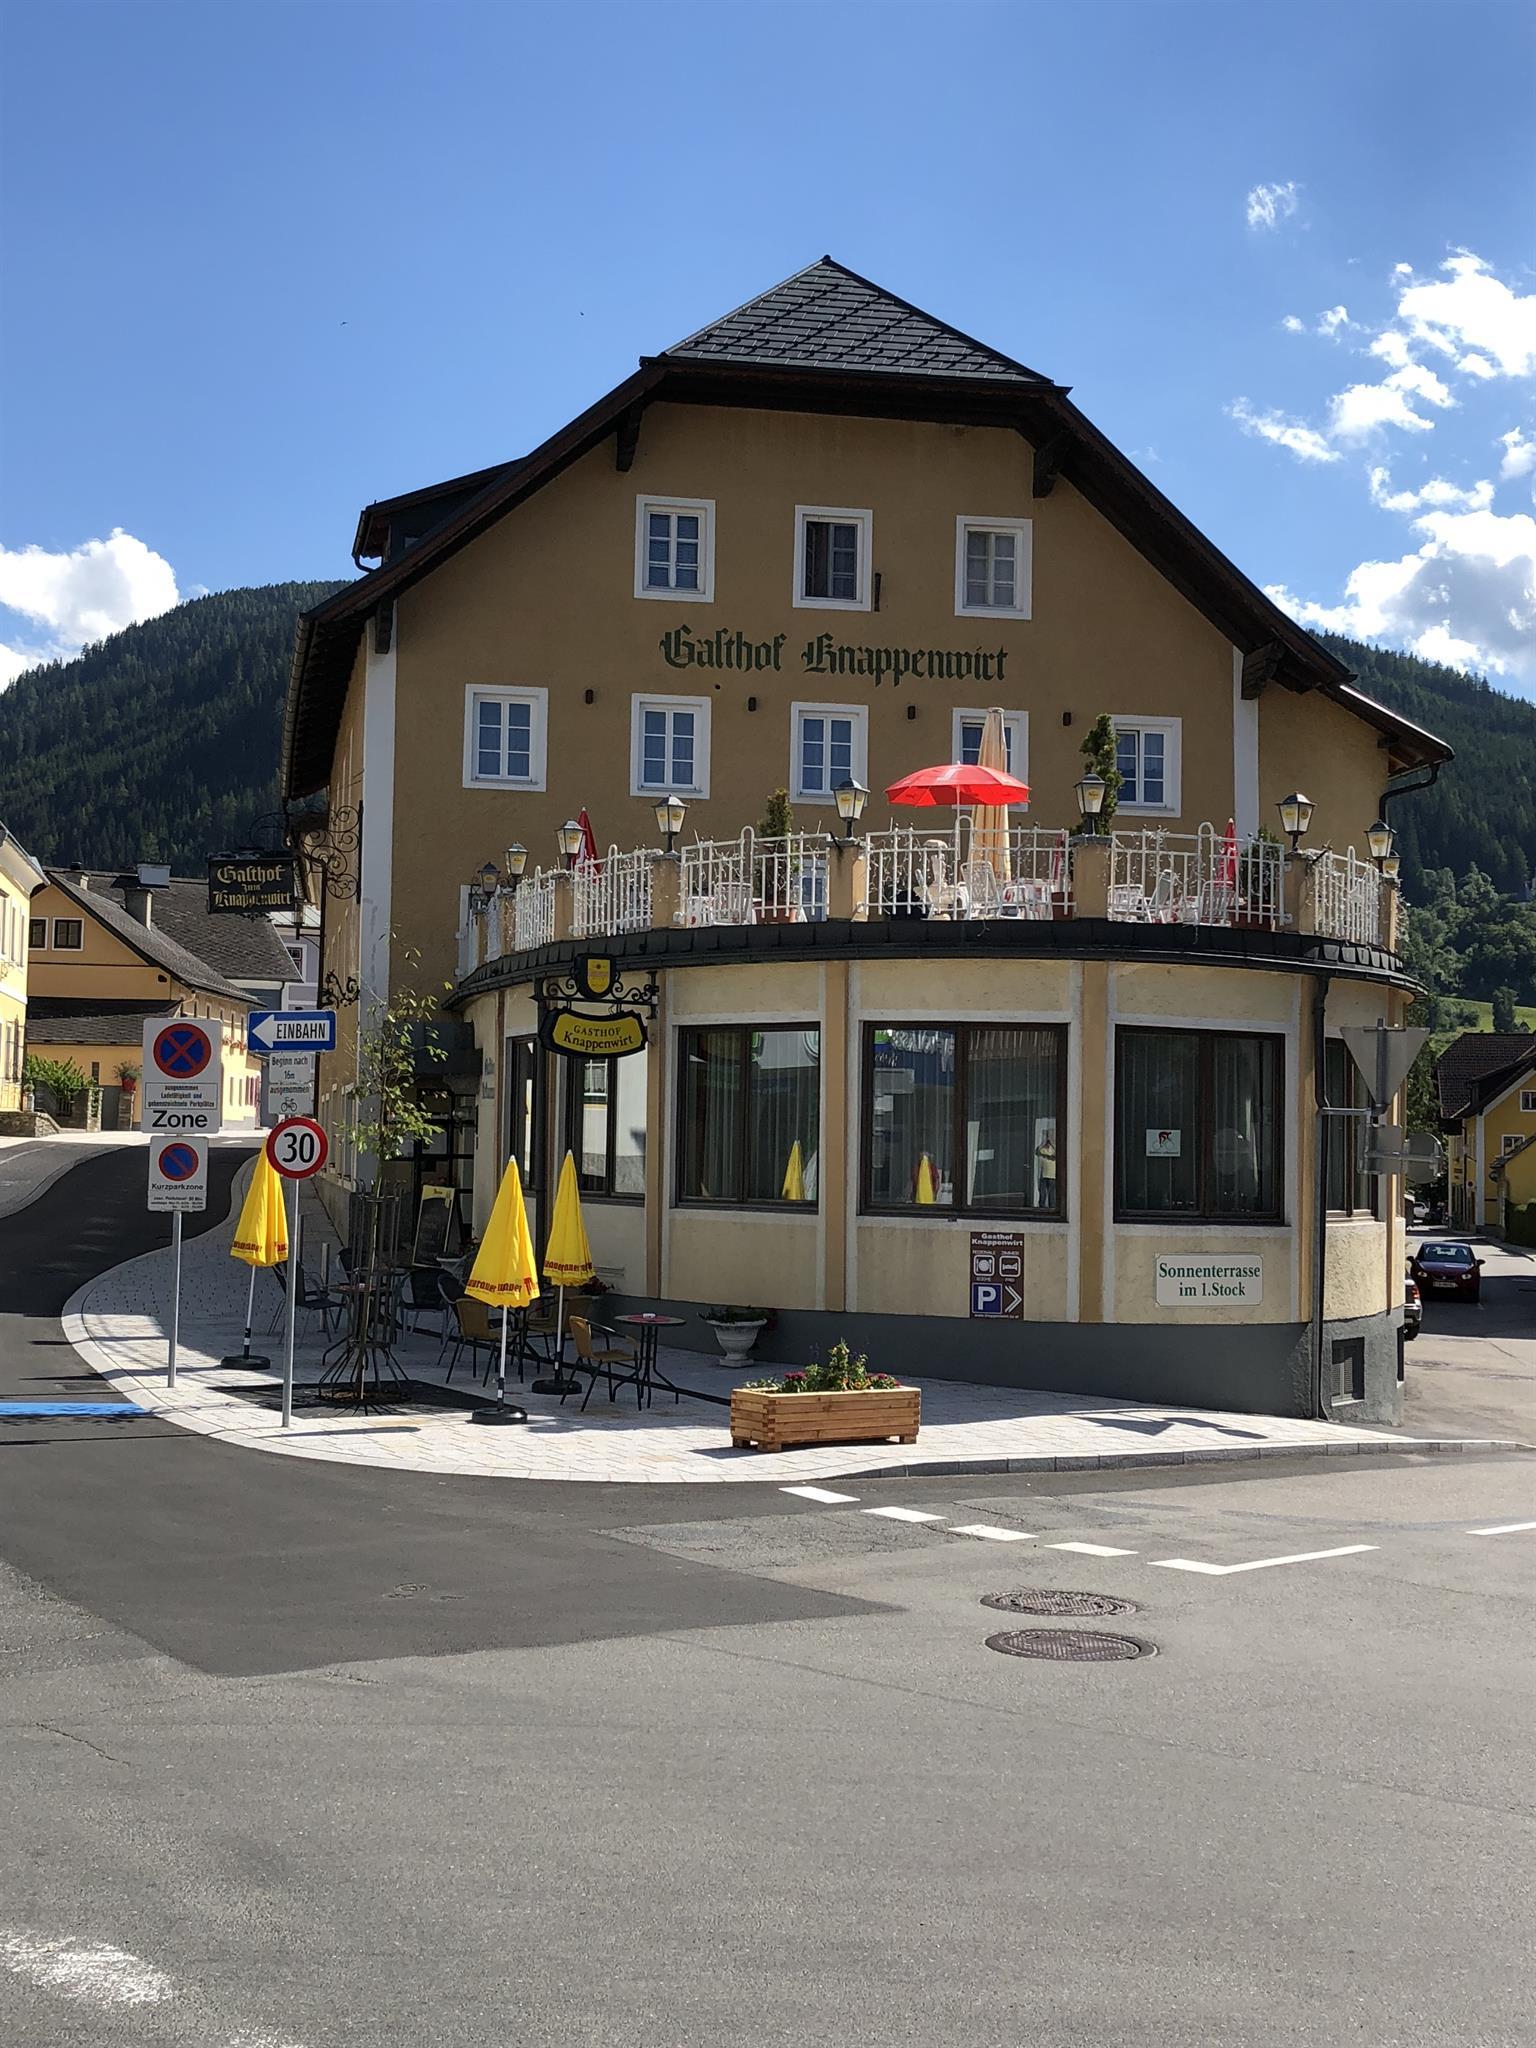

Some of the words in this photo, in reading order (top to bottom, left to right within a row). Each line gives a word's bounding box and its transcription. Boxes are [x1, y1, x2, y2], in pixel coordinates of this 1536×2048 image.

[801, 632, 1009, 687] Knappenwirt
[276, 1023, 326, 1039] EINBAHN
[573, 1025, 621, 1037] GASTHOF
[563, 1031, 633, 1051] Knappenwirt
[272, 1056, 293, 1068] Beginn
[293, 1056, 308, 1066] nach
[152, 1110, 208, 1128] Zone
[282, 1132, 315, 1163] 30
[152, 1183, 204, 1191] Kurzparkzone
[971, 1238, 1023, 1246] Knappenwirt
[1159, 1262, 1261, 1278] Sonnenterrasse
[1179, 1282, 1197, 1297] im
[978, 1286, 997, 1310] P
